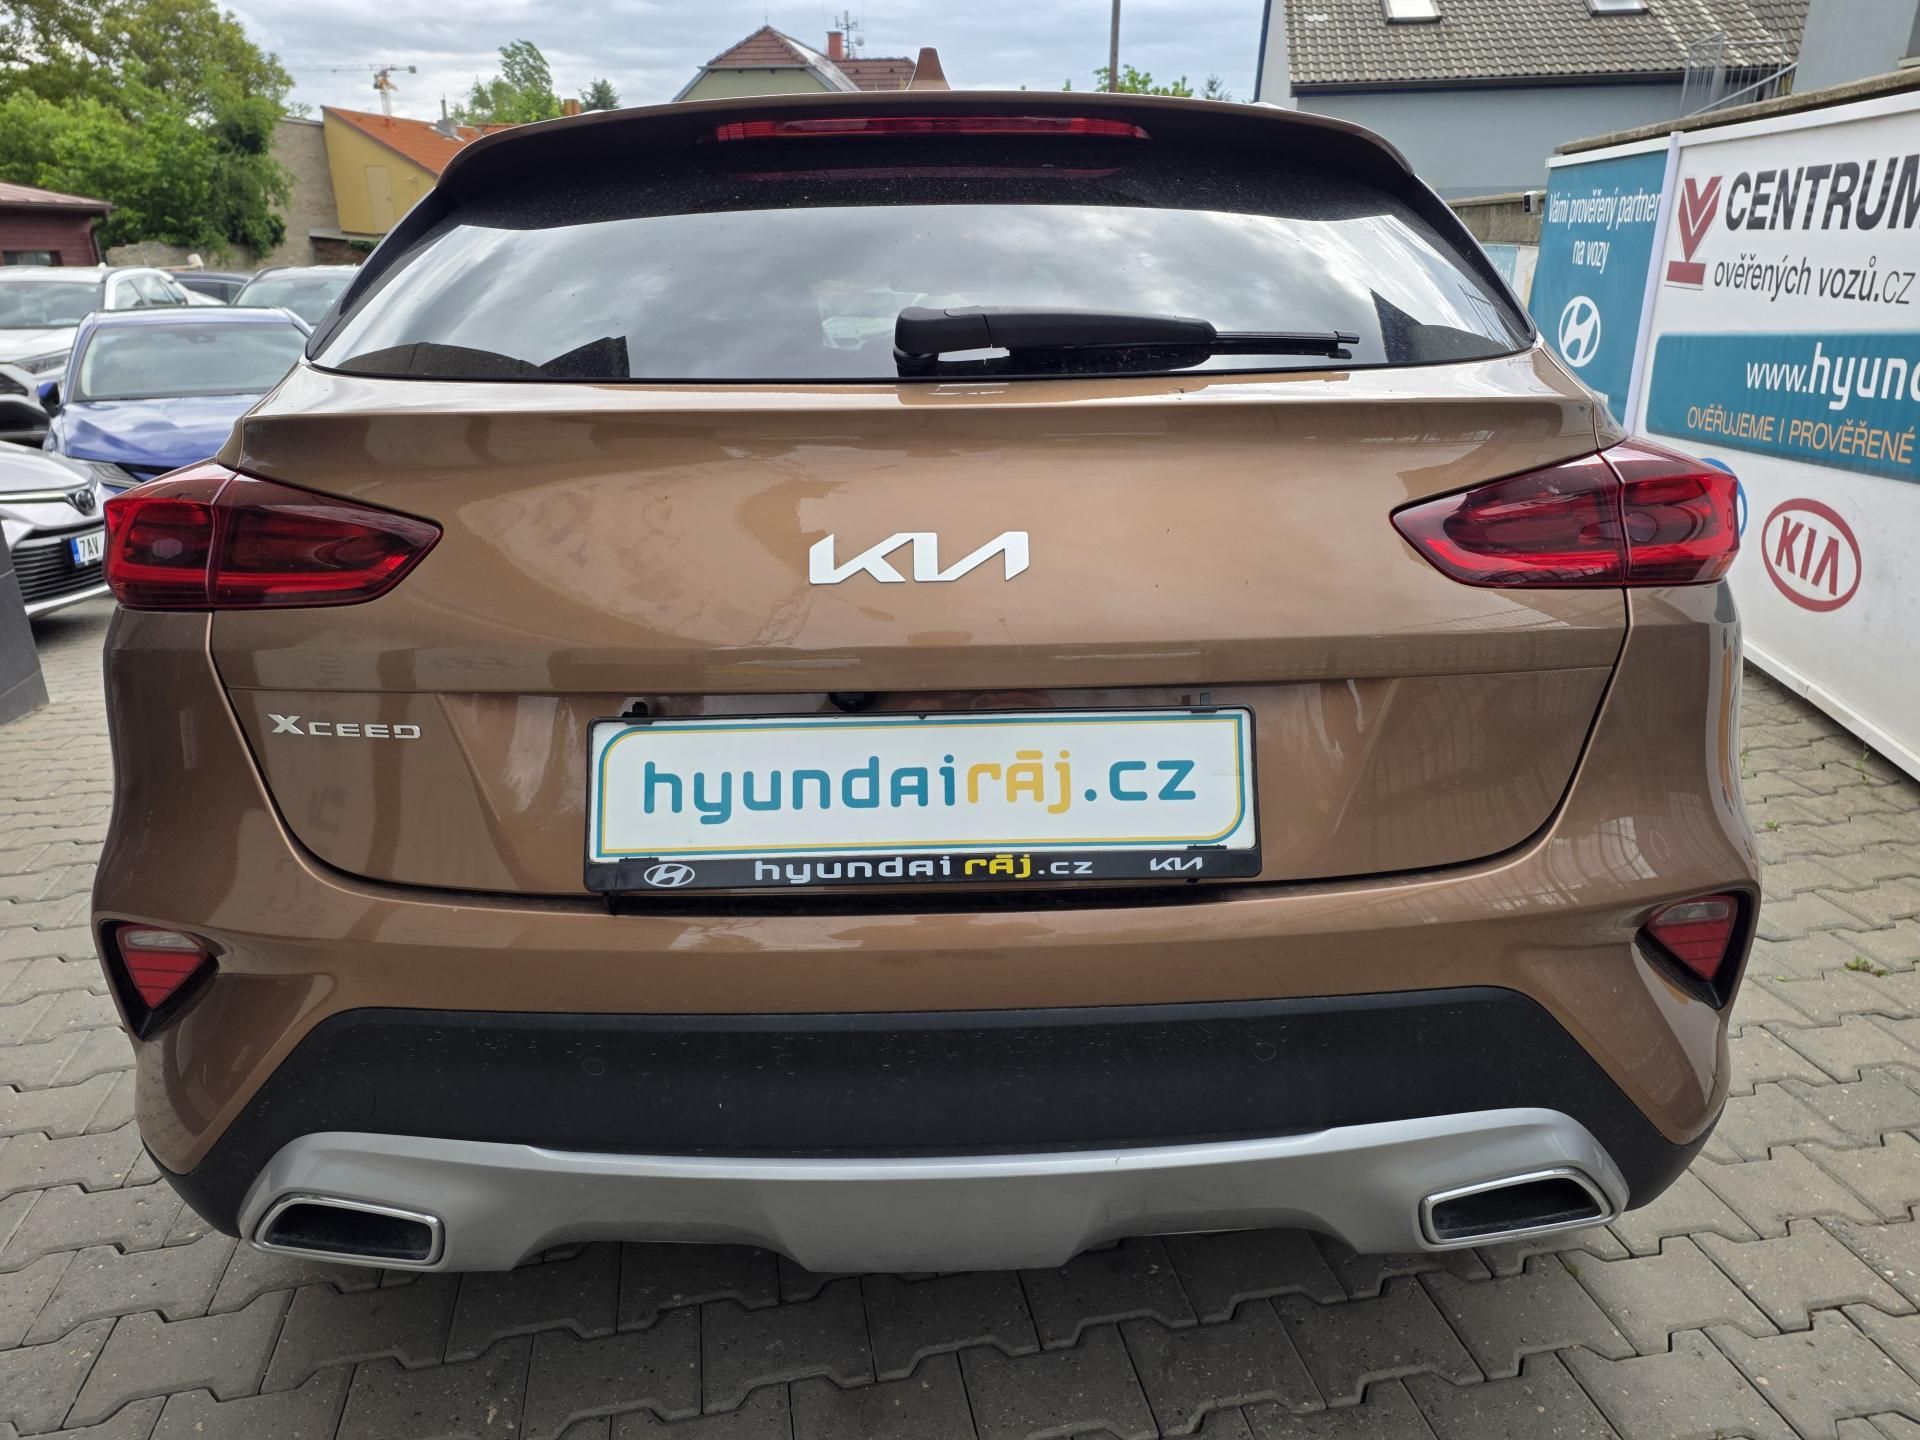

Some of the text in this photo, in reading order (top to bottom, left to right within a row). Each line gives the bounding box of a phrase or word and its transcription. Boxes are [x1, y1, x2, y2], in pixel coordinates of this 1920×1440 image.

[1548, 186, 1661, 230] Vámi prověřený partner
[1571, 239, 1610, 274] na vozy
[1714, 252, 1812, 302] ověřených
[1687, 403, 1916, 465] OVĚŘUJEME I PROVĚŘENÉ
[809, 531, 1029, 584] KIA
[1774, 515, 1840, 597] KIA
[268, 713, 421, 739] XCEED
[754, 855, 952, 884] hyundai
[1149, 856, 1204, 872] KIA
